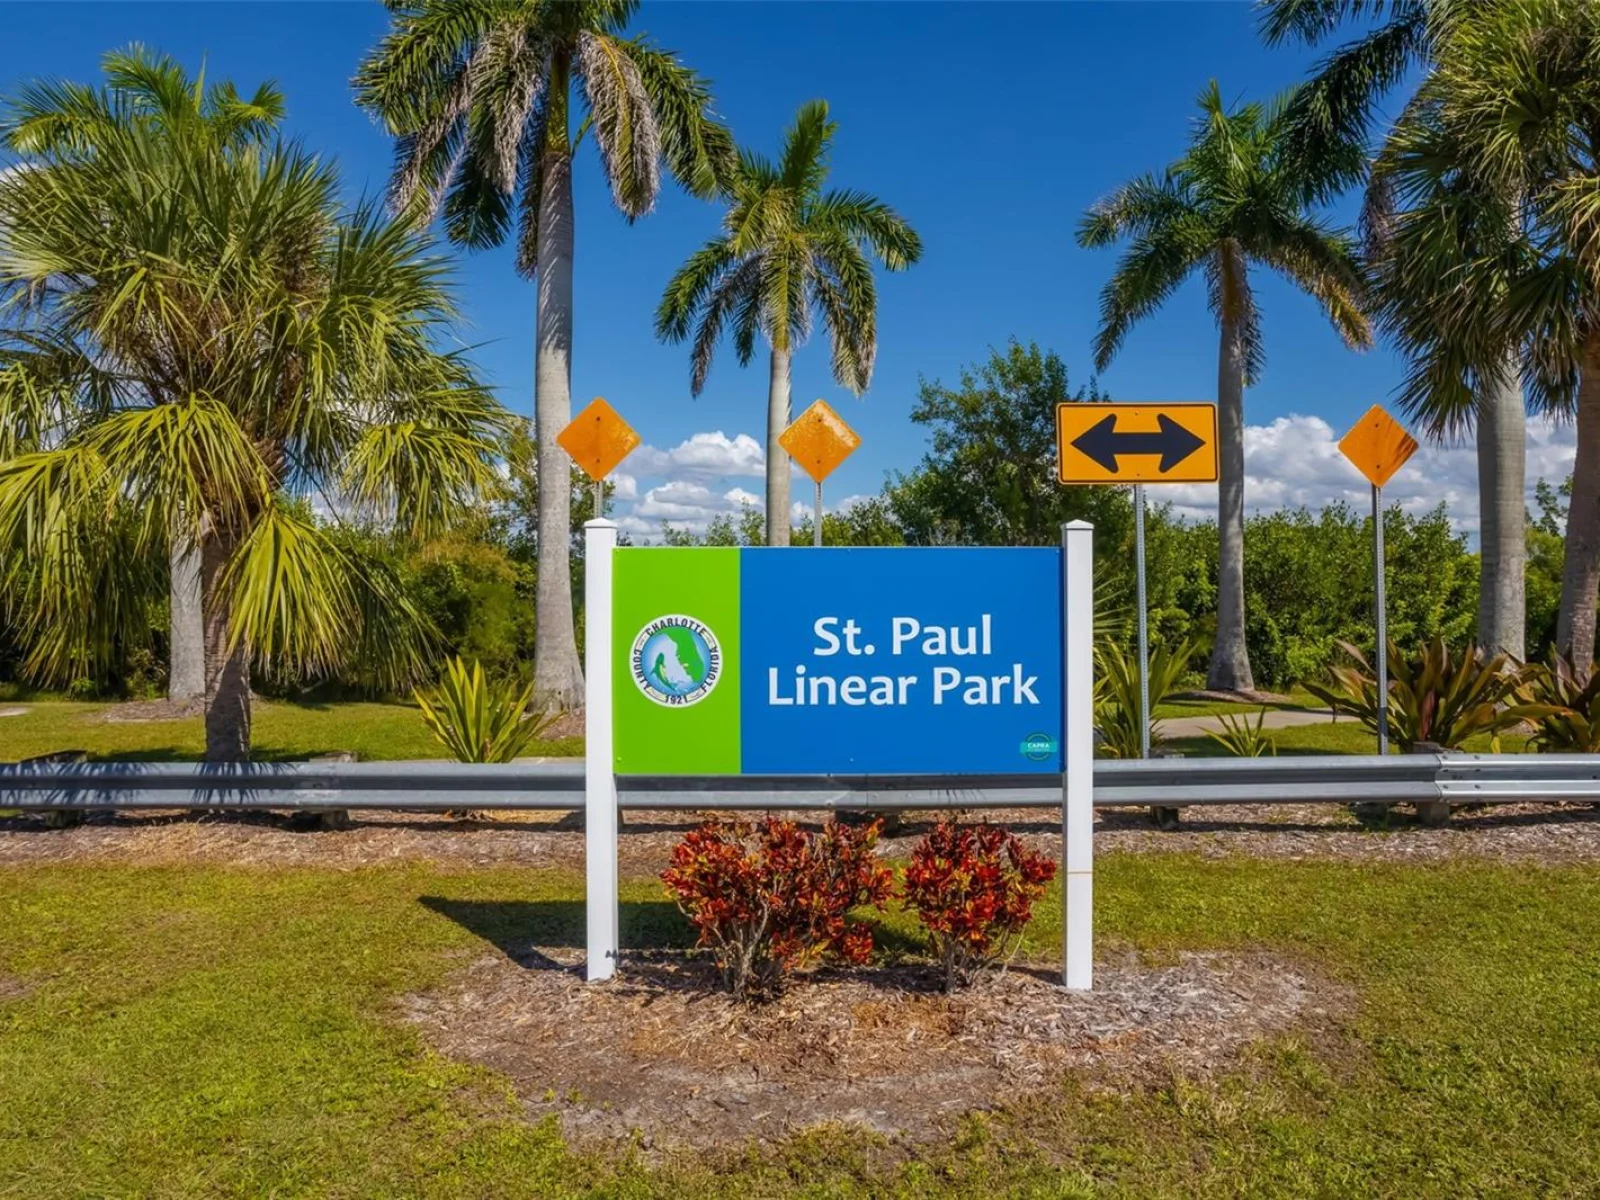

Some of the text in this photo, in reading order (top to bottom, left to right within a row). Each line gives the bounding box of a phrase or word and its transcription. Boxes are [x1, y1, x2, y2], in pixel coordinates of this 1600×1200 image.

[645, 617, 707, 637] CHARLOTTE
[813, 613, 992, 656] St. Paul
[633, 649, 651, 691] COUNTY
[700, 645, 720, 693] FLORIDA
[768, 663, 1040, 706] Linear Park
[665, 694, 689, 705] 1921
